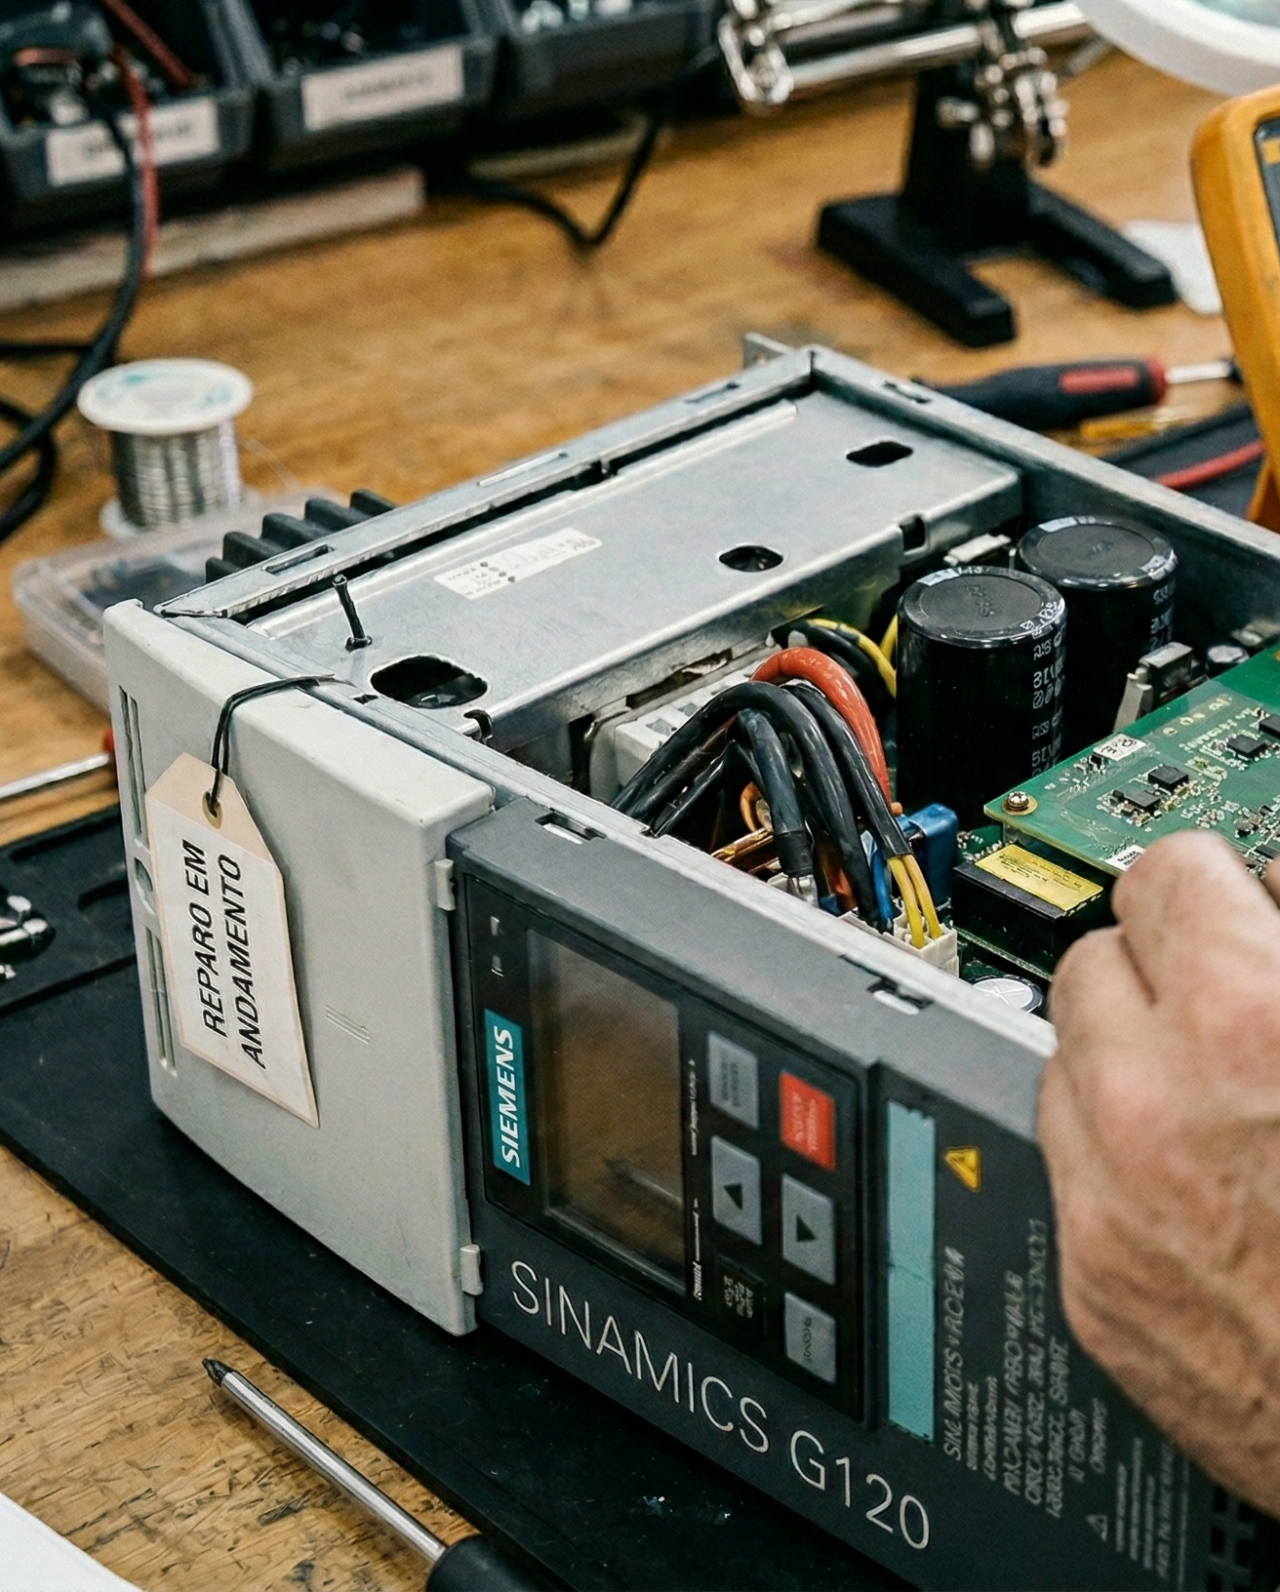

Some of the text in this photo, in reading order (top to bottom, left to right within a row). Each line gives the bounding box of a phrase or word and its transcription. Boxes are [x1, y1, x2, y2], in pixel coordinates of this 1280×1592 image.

[181, 838, 228, 1039] REPARO EM
[217, 853, 267, 1070] ANDAMENTO
[493, 1024, 522, 1169] SIEMENS
[510, 1259, 770, 1454] SINAMICS
[789, 1429, 930, 1550] G120
